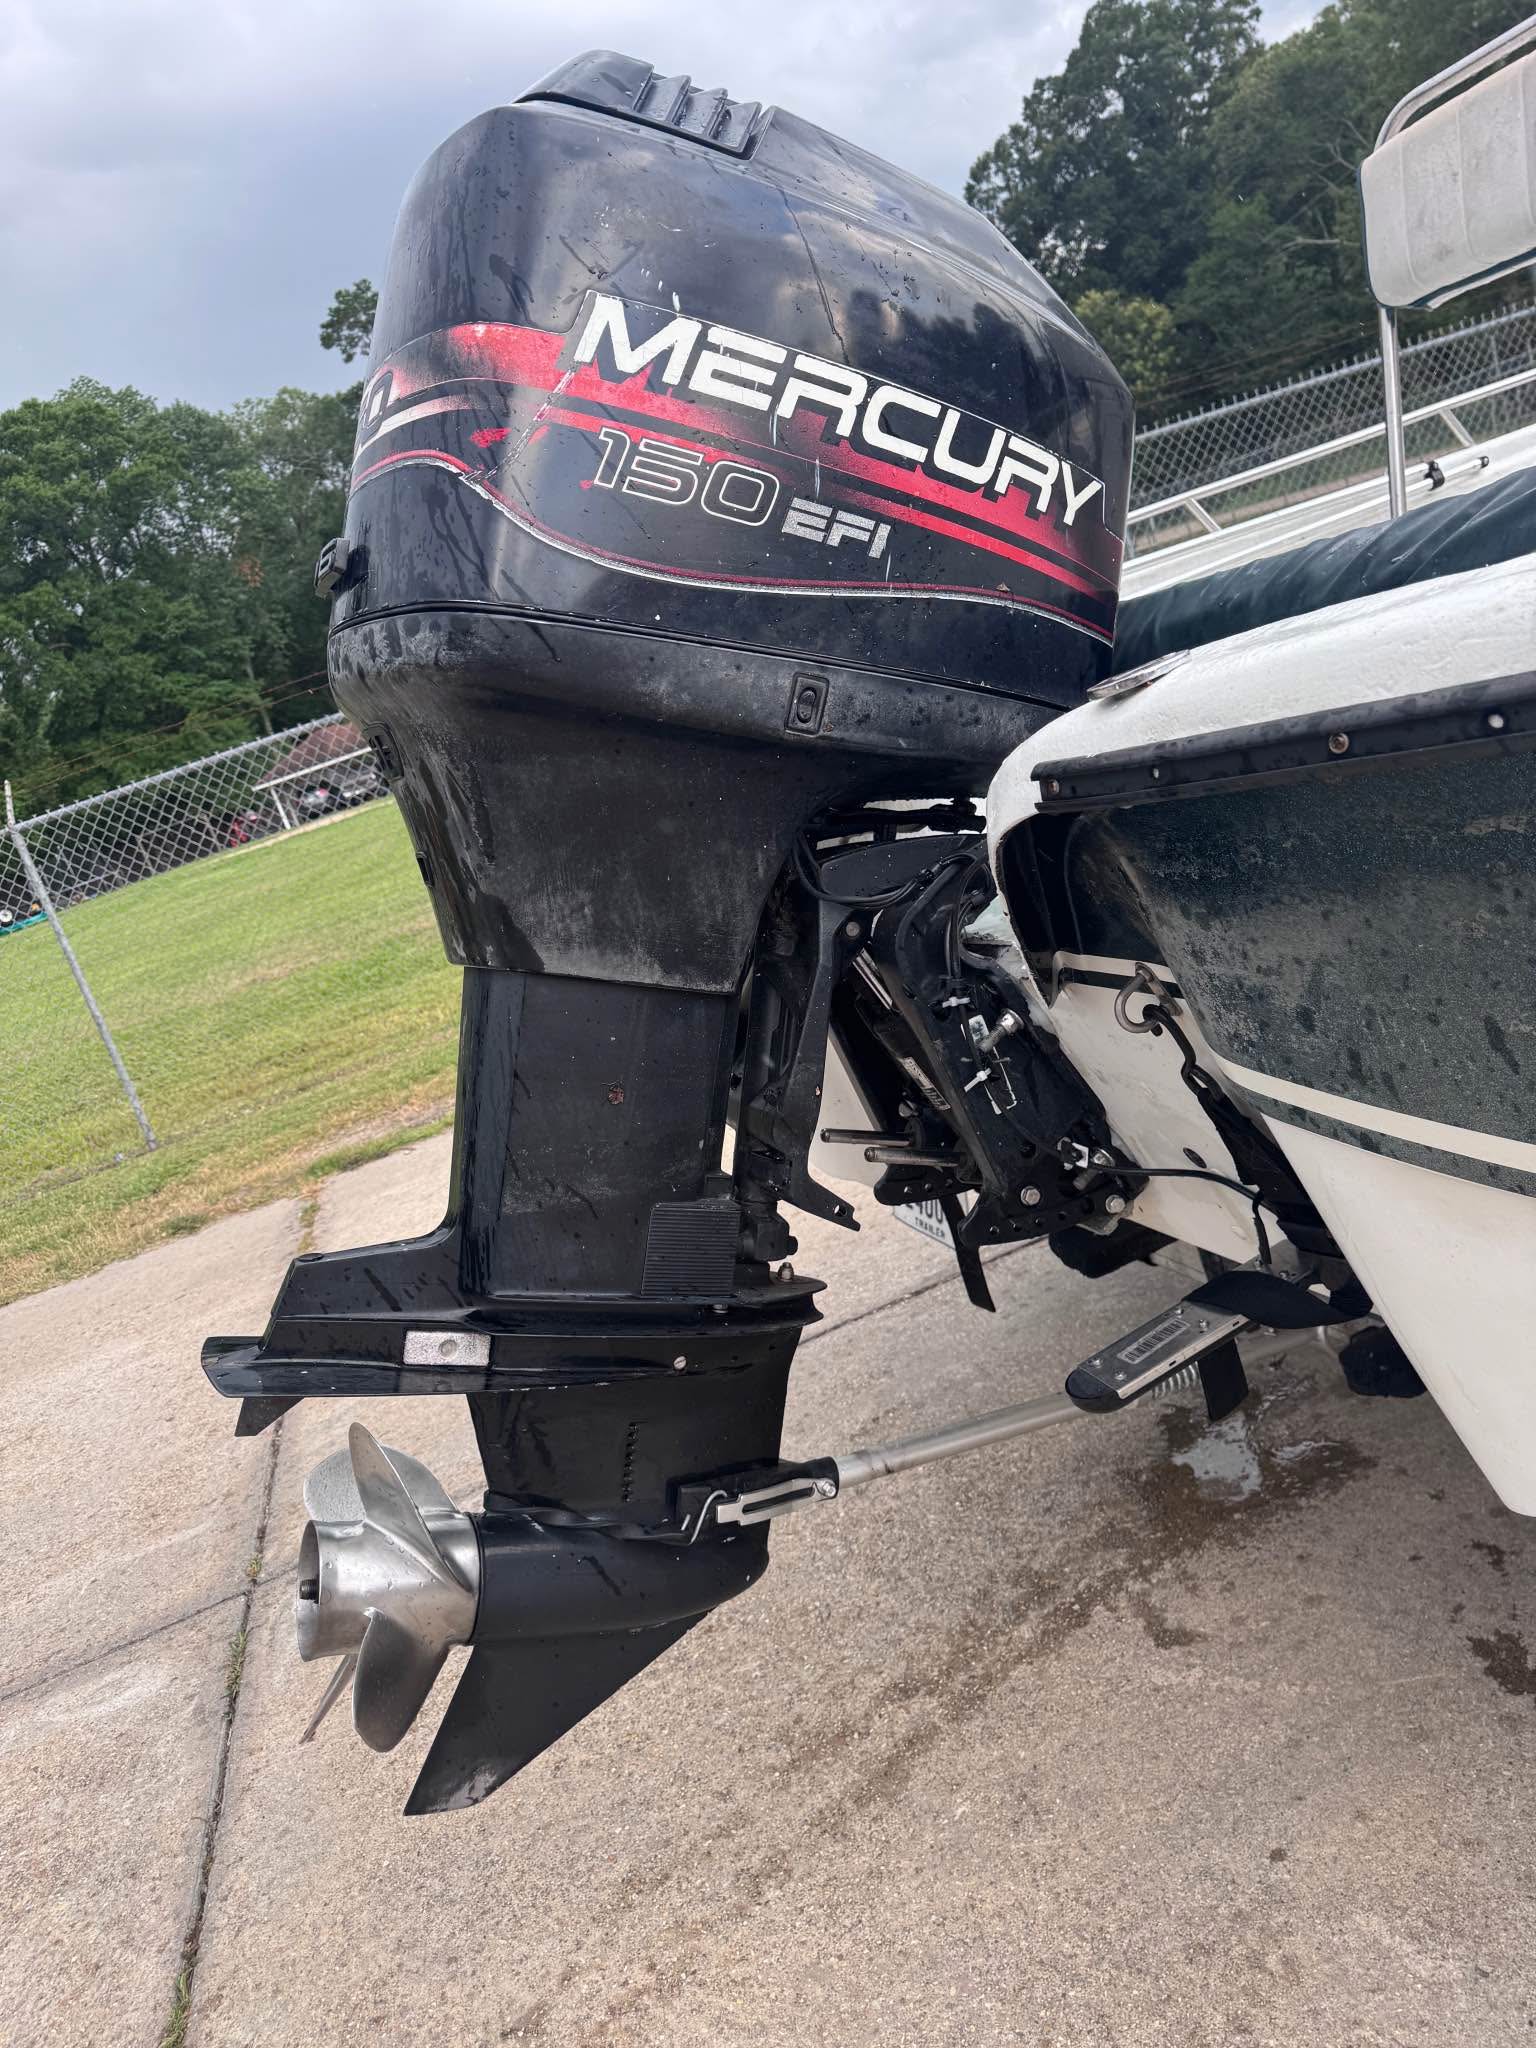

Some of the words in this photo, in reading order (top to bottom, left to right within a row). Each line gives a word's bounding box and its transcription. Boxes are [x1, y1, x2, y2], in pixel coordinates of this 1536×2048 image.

[574, 296, 1103, 526] MERCURY
[594, 427, 780, 527] 150
[781, 497, 892, 560] EFI
[915, 1217, 945, 1238] TRAILER
